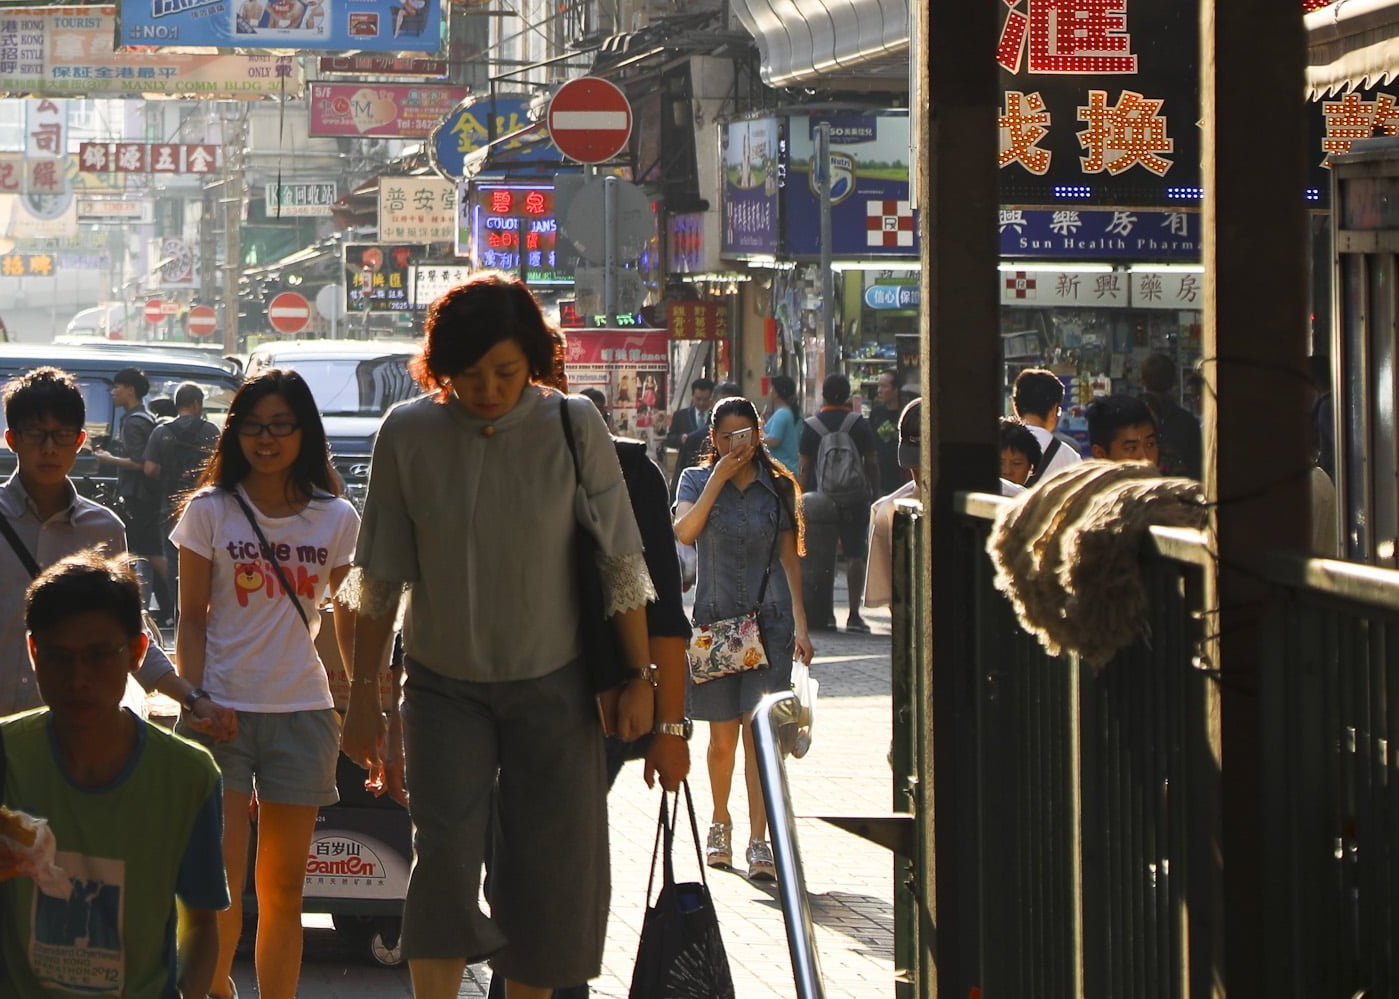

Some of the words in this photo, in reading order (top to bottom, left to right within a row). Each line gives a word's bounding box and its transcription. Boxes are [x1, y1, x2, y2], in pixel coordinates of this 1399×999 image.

[54, 17, 102, 29] TOURIST
[1019, 237, 1052, 249] Sun
[1063, 237, 1126, 249] Health
[1055, 273, 1201, 303] 新興藥房
[295, 544, 329, 566] me
[233, 559, 319, 608] pink
[316, 842, 360, 857] 百岁山
